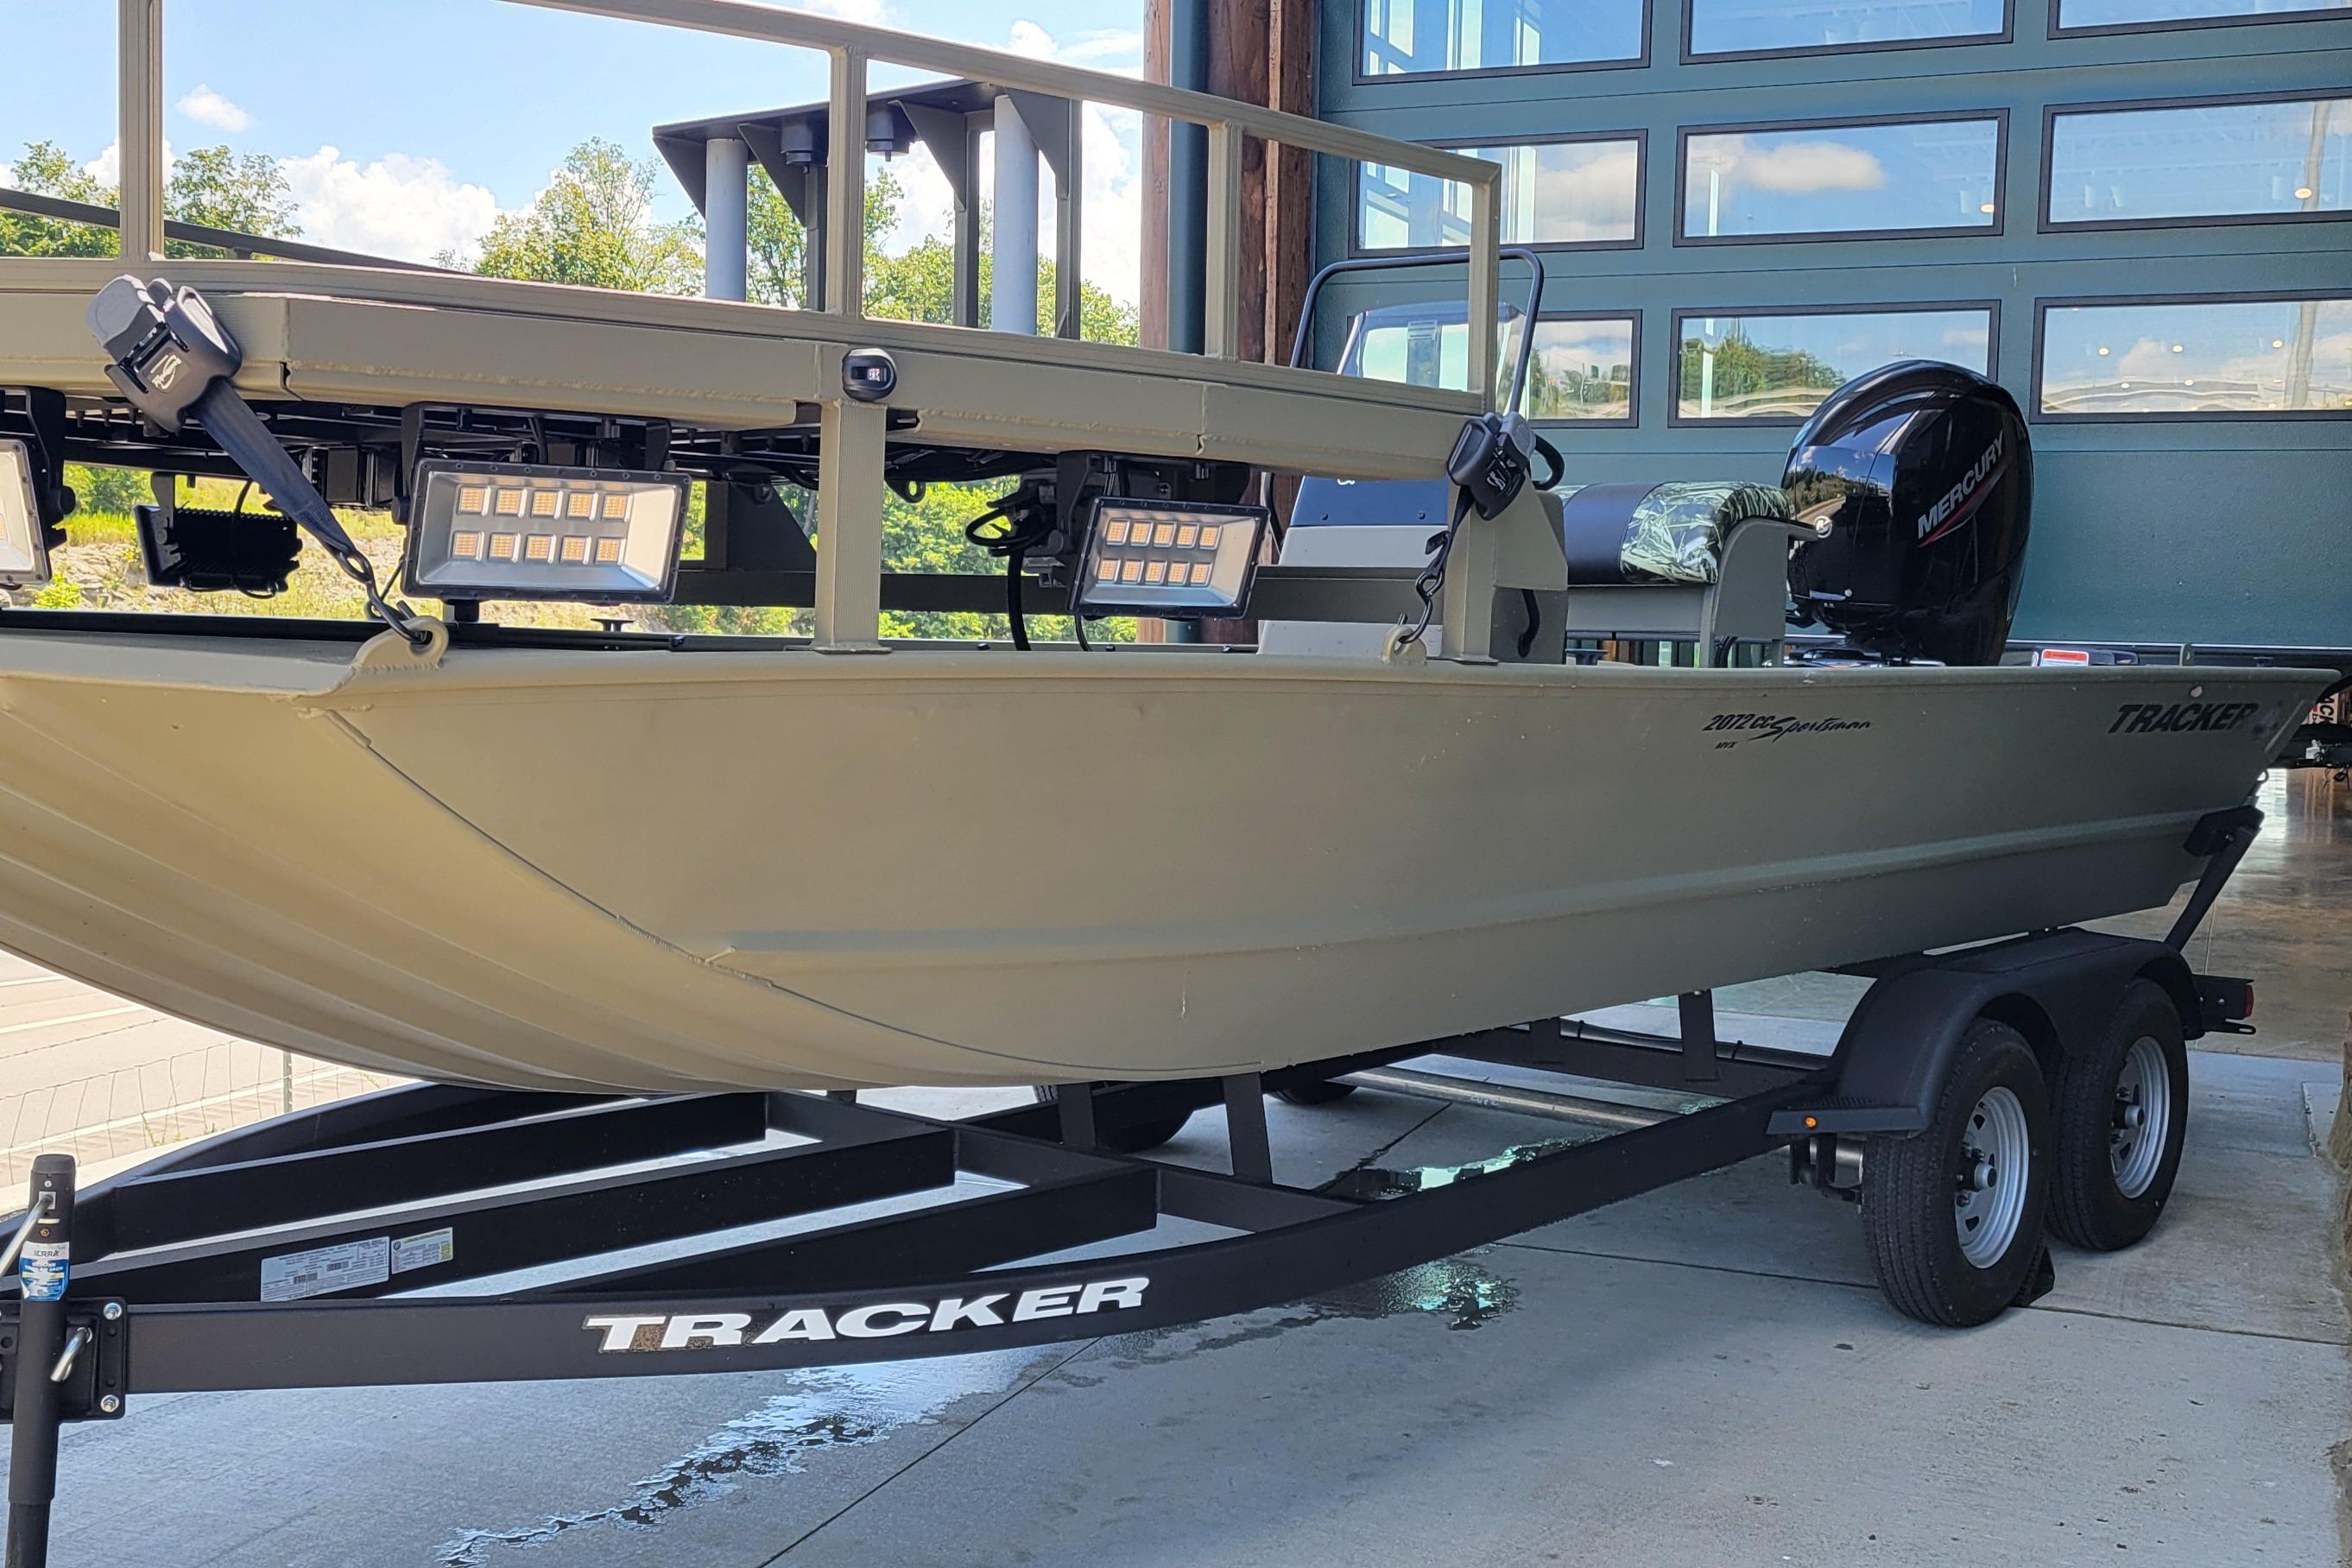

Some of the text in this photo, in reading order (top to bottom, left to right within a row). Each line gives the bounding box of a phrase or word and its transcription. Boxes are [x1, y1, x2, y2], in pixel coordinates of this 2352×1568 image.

[1918, 429, 2003, 539] MERCURY
[1748, 717, 1871, 743] Sportsman
[2108, 703, 2260, 734] TRACKER
[585, 1277, 1150, 1351] TRACKER
